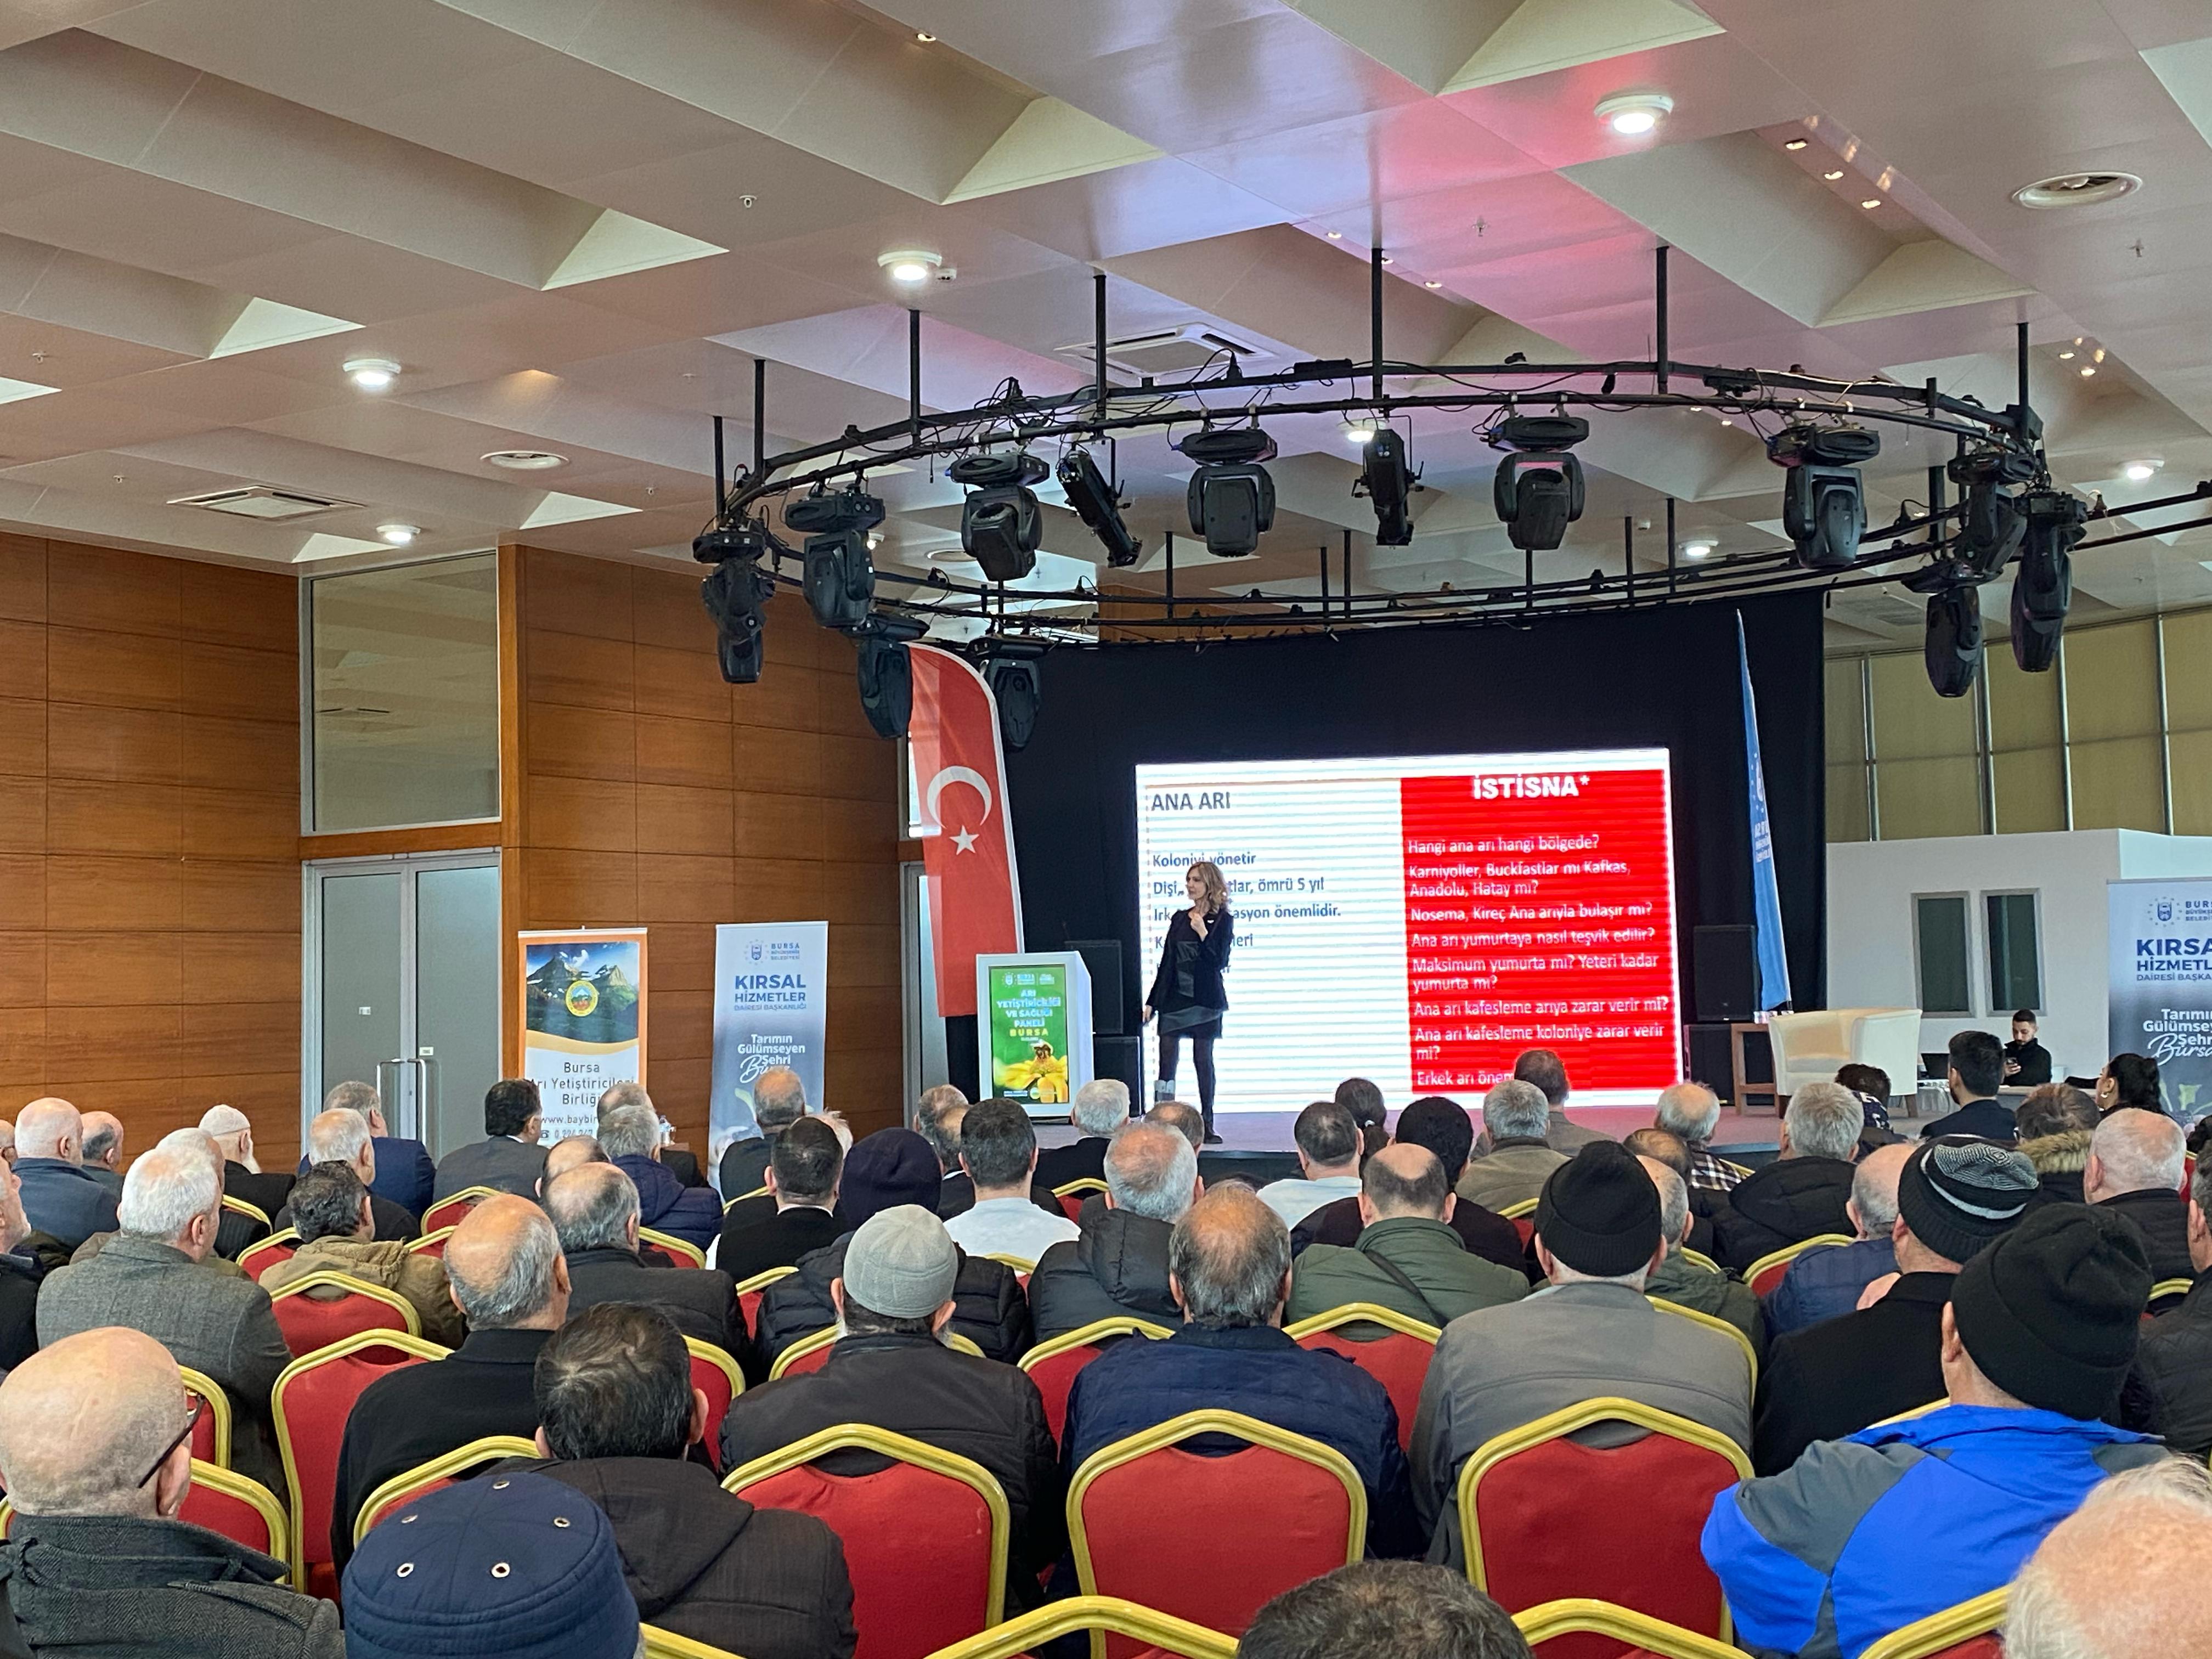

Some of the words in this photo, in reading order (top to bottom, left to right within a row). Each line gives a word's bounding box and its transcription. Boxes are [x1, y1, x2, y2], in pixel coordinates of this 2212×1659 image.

[1152, 793, 1193, 811] ANA
[1199, 792, 1231, 809] ARI
[1408, 839, 1446, 855] Hangi
[1449, 843, 1473, 852] ana
[1477, 842, 1494, 851] arı
[1498, 837, 1534, 853] hangi
[1539, 834, 1599, 851] bölgede?
[1487, 861, 1559, 877] Buckfastlar
[1584, 860, 1630, 876] Kafkas,
[1258, 878, 1293, 891] ömrü
[1297, 878, 1305, 891] 5
[1311, 877, 1324, 894] yıl
[1410, 883, 1468, 898] Anadolu,
[1472, 881, 1509, 898] Hatay
[1515, 879, 1538, 895] mı?
[1275, 904, 1341, 918] önemlidir.
[1411, 908, 1469, 923] Nosema,
[1473, 906, 1505, 922] Kireç
[1510, 906, 1535, 919] Ana
[1539, 904, 1575, 922] arıyla
[1579, 903, 1623, 918] bulaşır
[1628, 902, 1652, 916] mı?
[1412, 934, 1437, 947] Ana
[1442, 935, 1458, 946] arı
[1462, 934, 1532, 950] yumurtaya
[1537, 929, 1567, 944] nasıl
[1571, 928, 1609, 945] teşvik
[1613, 927, 1655, 942] edilir?
[2137, 938, 2212, 956] KIRSA
[1413, 958, 1485, 973] Maksimum
[1490, 957, 1545, 973] yumurta
[1550, 955, 1575, 969] mı?
[1578, 955, 1617, 969] Yeteri
[1621, 953, 1659, 967] kadar
[2137, 956, 2212, 971] HİZMETL
[735, 974, 806, 989] KIRSAL
[1413, 978, 1469, 994] yumurta
[1474, 974, 1498, 989] mı?
[2137, 972, 2175, 981] DAİRESİ
[2178, 973, 2212, 982] BAŞKA
[735, 990, 806, 1002] HİZMETLER
[1414, 1002, 1440, 1016] Ana
[1444, 1005, 1461, 1015] arı
[1465, 1001, 1532, 1015] kafesleme
[1536, 1002, 1568, 1016] arıya
[1571, 1001, 1605, 1012] zarar
[1610, 998, 1640, 1012] verir
[1644, 996, 1668, 1011] mi?
[751, 1034, 793, 1043] Tarımın
[1009, 1028, 1048, 1036] BURSA
[1414, 1028, 1441, 1042] Ana
[1445, 1030, 1462, 1041] arı
[1465, 1025, 1532, 1041] kafesleme
[1536, 1024, 1592, 1041] koloniye
[1596, 1026, 1630, 1037] zarar
[1634, 1023, 1664, 1037] verir
[2178, 1034, 2212, 1047] Şehr
[737, 1044, 805, 1054] Gülümseyen
[1415, 1045, 1440, 1060] mi?
[564, 1062, 600, 1073] Bursa
[1417, 1070, 1453, 1086] Erkek
[1457, 1073, 1474, 1084] arı
[1478, 1069, 1514, 1084] önem
[542, 1115, 597, 1126] www.baybir
